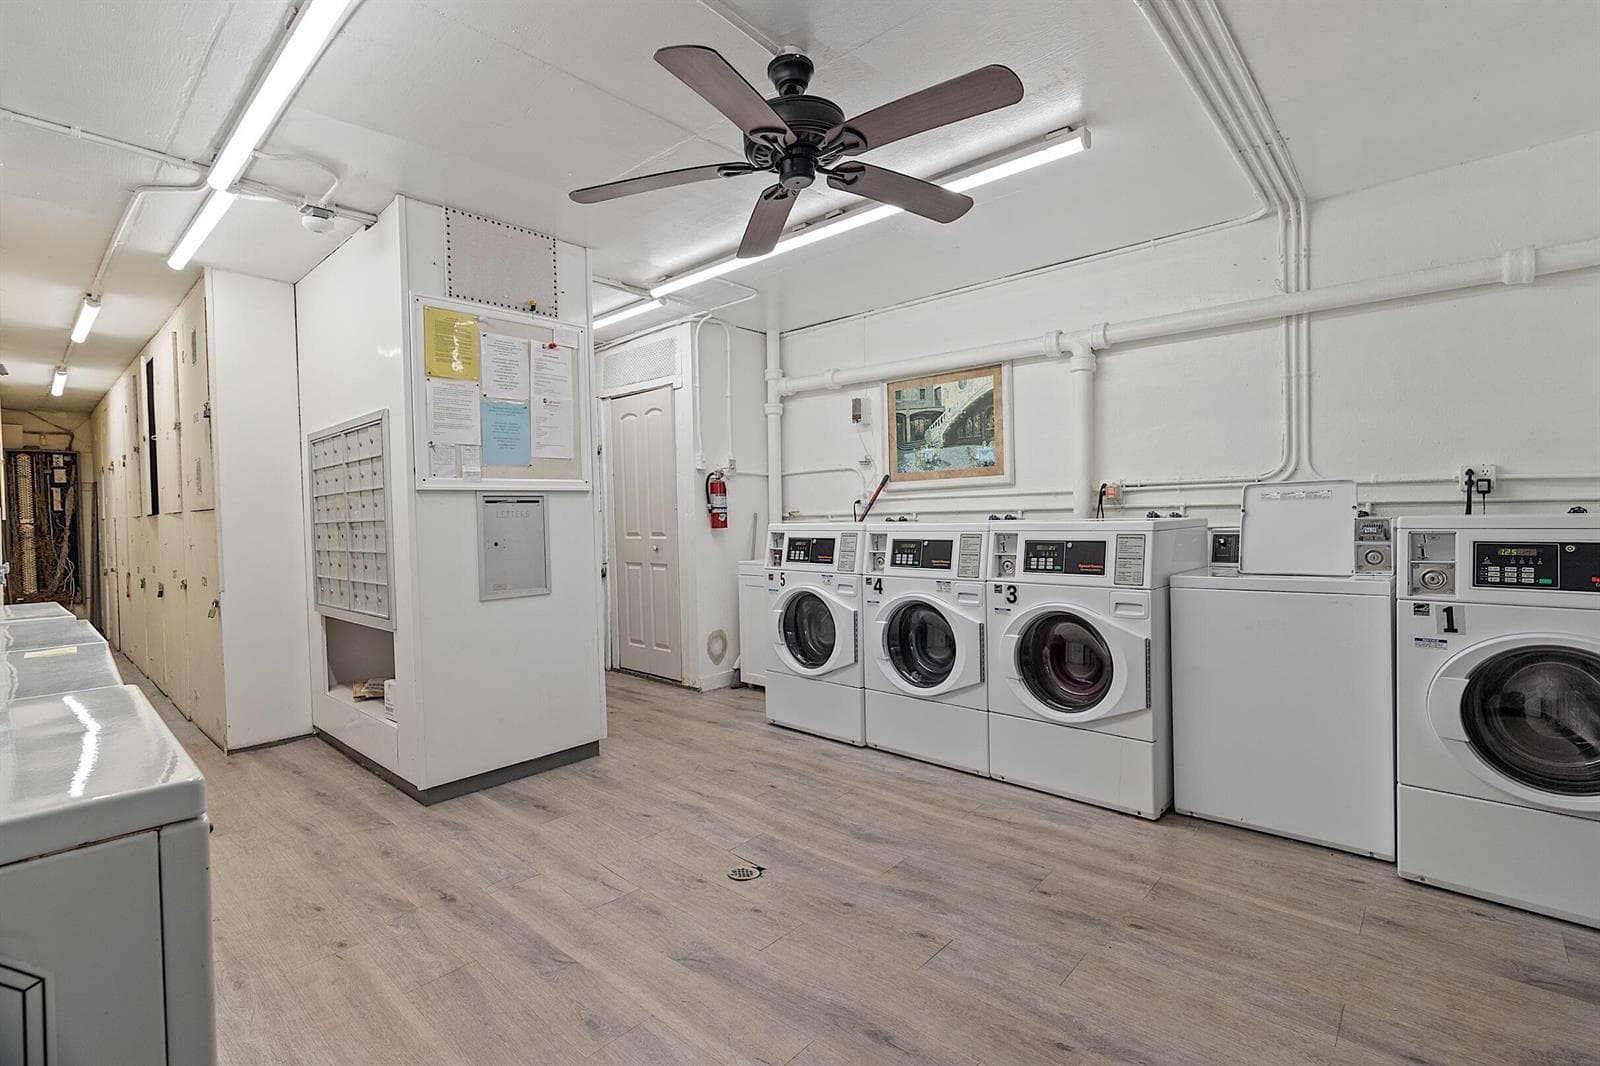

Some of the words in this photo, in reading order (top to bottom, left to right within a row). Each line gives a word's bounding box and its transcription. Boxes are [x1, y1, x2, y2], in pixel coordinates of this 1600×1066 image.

[496, 510, 530, 519] LETTERS
[779, 572, 786, 587] 5
[873, 578, 883, 595] 4
[1006, 584, 1018, 604] 3
[1442, 606, 1458, 633] 1
